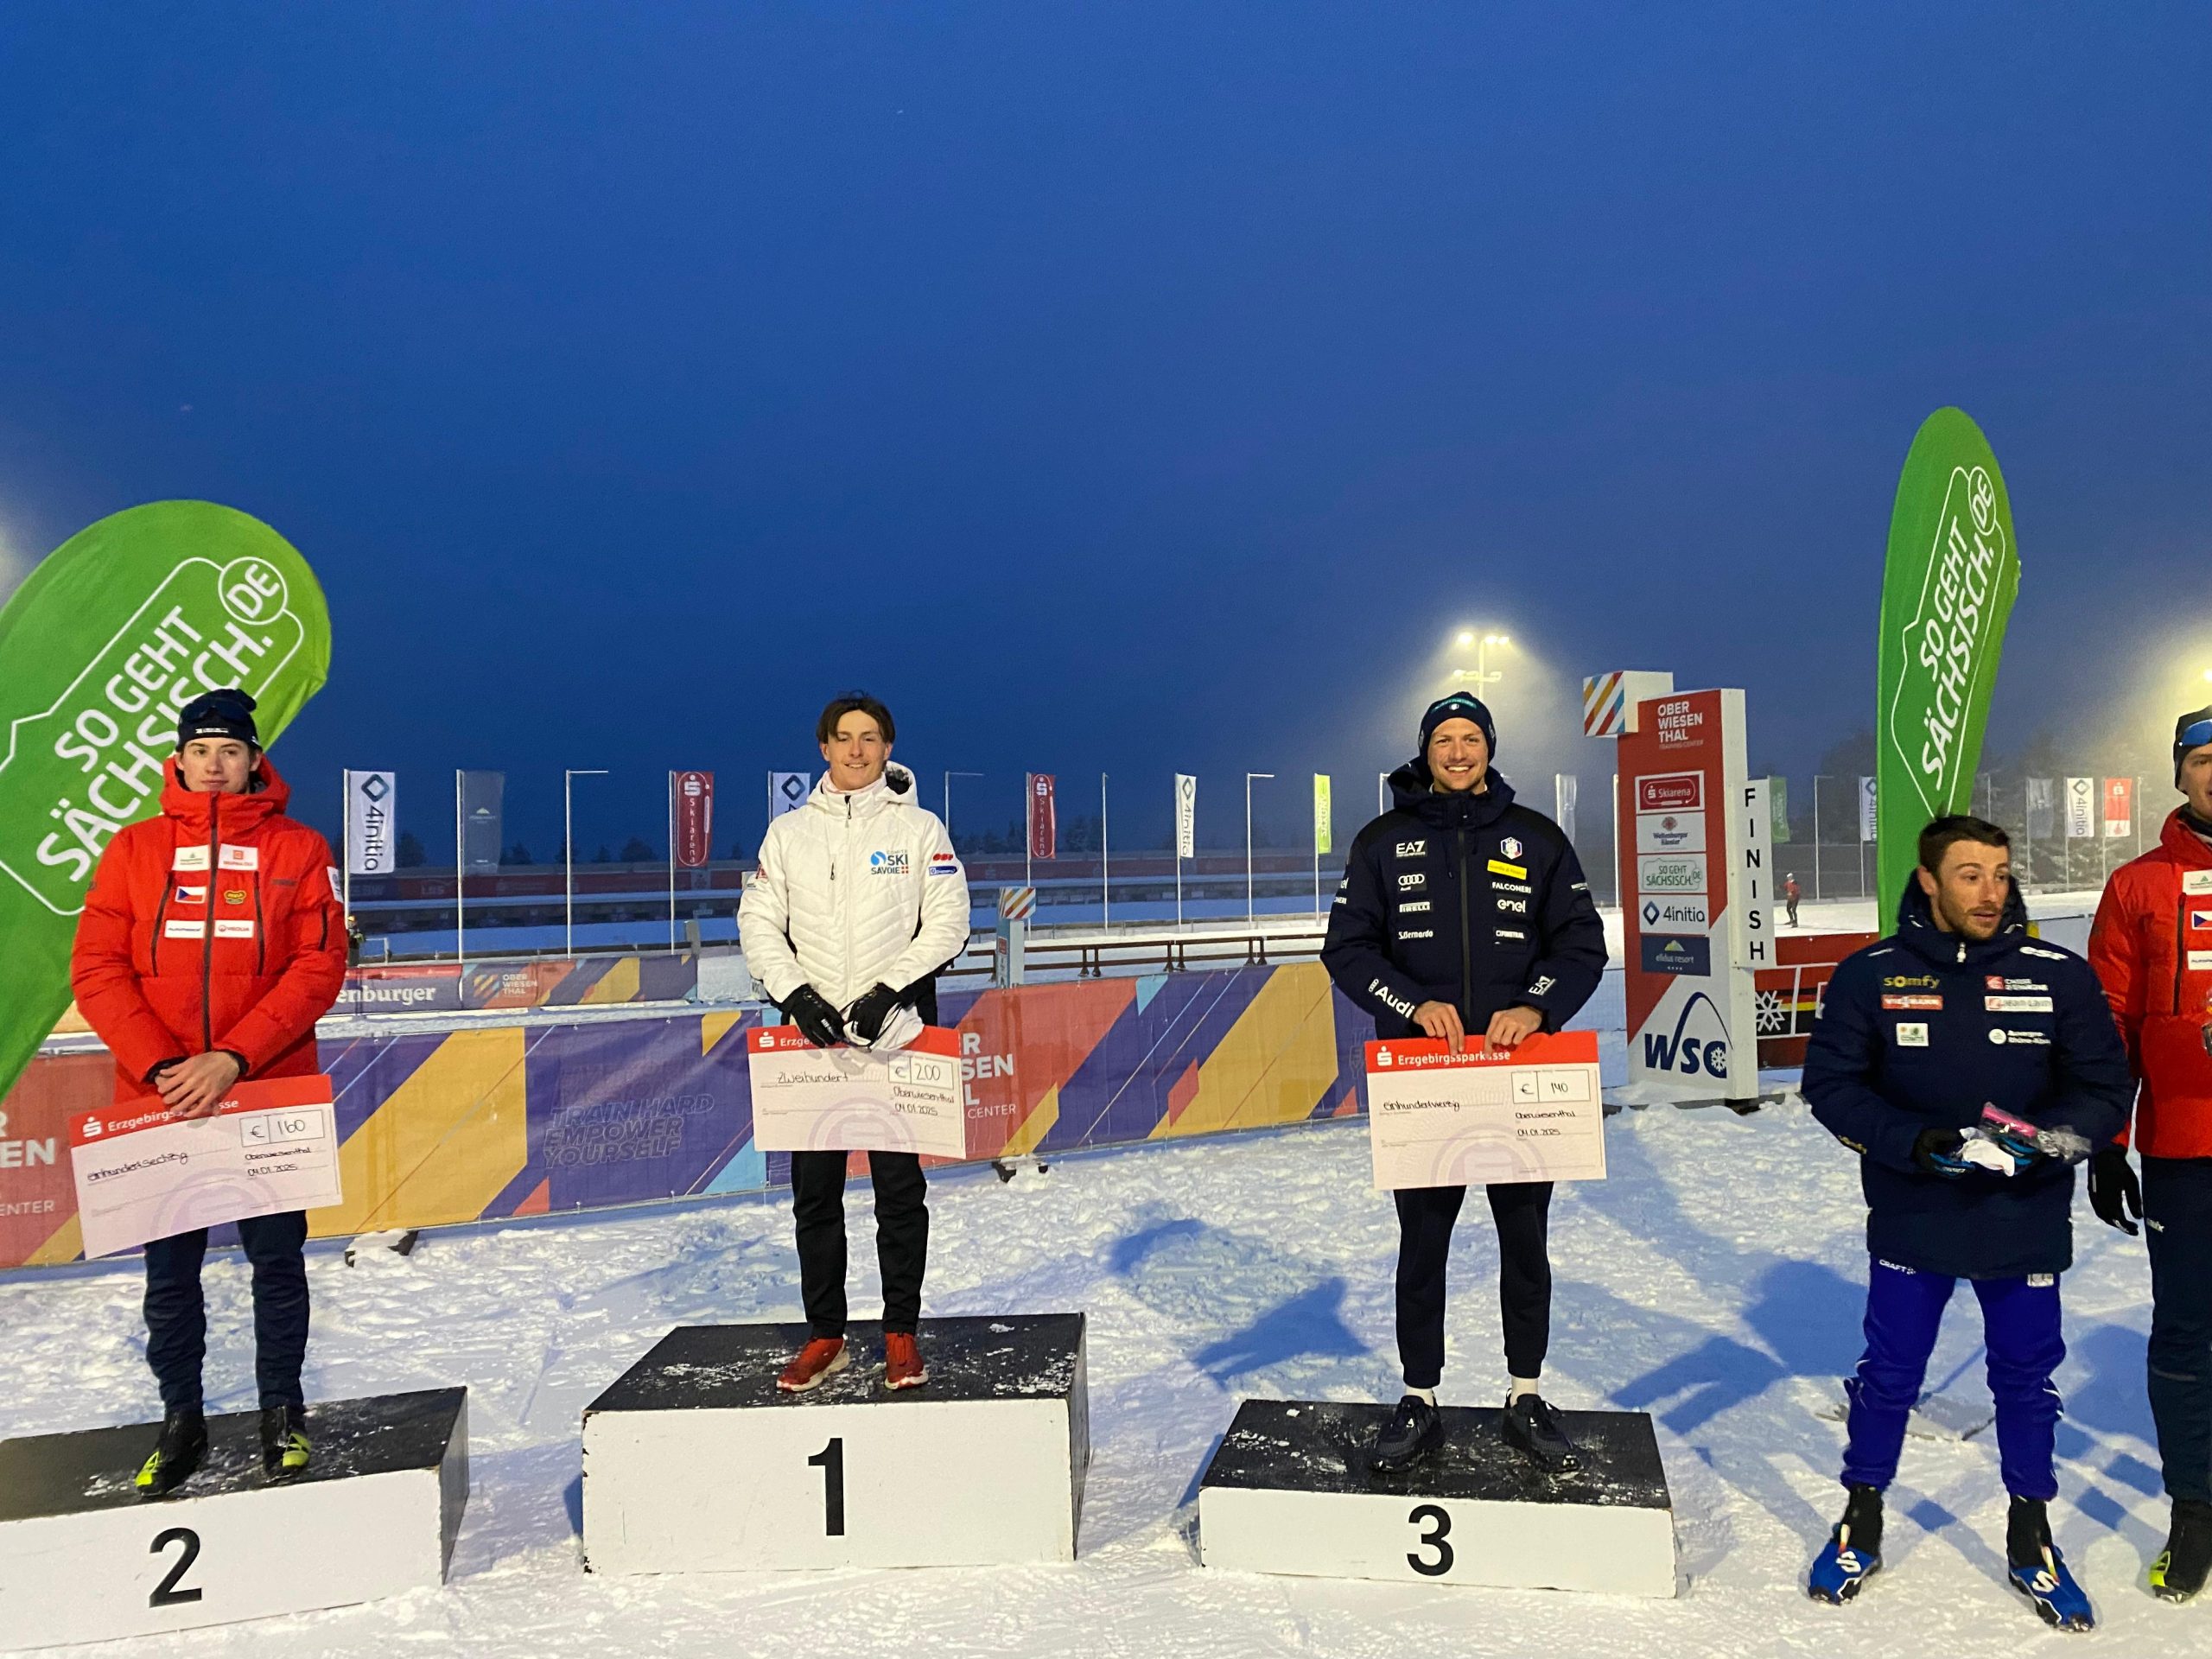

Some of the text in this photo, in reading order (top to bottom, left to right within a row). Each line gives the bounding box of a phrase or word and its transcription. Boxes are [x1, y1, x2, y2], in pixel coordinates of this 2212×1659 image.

[1971, 473, 1993, 530] DE
[226, 563, 281, 619] DE
[1920, 516, 1968, 681] SO GEHT
[1923, 533, 1994, 791] SÄCHSISCH.
[54, 606, 202, 772] SO GEHT
[1657, 701, 1689, 716] OBER
[1658, 712, 1703, 729] WIESEN
[1658, 728, 1689, 743] THAL
[1658, 787, 1692, 798] Skiarena
[364, 805, 385, 871] 4initia
[1396, 841, 1425, 854] EA7
[887, 855, 908, 866] SKI
[1659, 865, 1687, 874] SO GEHT
[871, 866, 900, 874] SAVOIE
[1744, 787, 1765, 961] FINISH
[1492, 882, 1531, 893] FALCONERI
[1497, 899, 1526, 913] enel
[1663, 906, 1705, 923] 4initia
[1884, 975, 1940, 989] somfy
[335, 985, 436, 1006] enburger
[1375, 986, 1415, 1019] Audi
[962, 1053, 1014, 1081] SEN
[1398, 1051, 1511, 1067] Erzgebirgssparksse
[914, 1063, 941, 1082] 200
[1551, 1082, 1568, 1094] 140
[550, 1093, 715, 1128] TRAIN HARD
[967, 1103, 1016, 1120] CENTER
[277, 1119, 305, 1135] 160
[544, 1116, 684, 1148] EMPOWER
[543, 1136, 682, 1169] YOURSELF
[1878, 1259, 1906, 1274] CRAFT
[808, 1438, 845, 1537] 1
[1406, 1503, 1453, 1576] 3
[149, 1527, 203, 1609] 2
